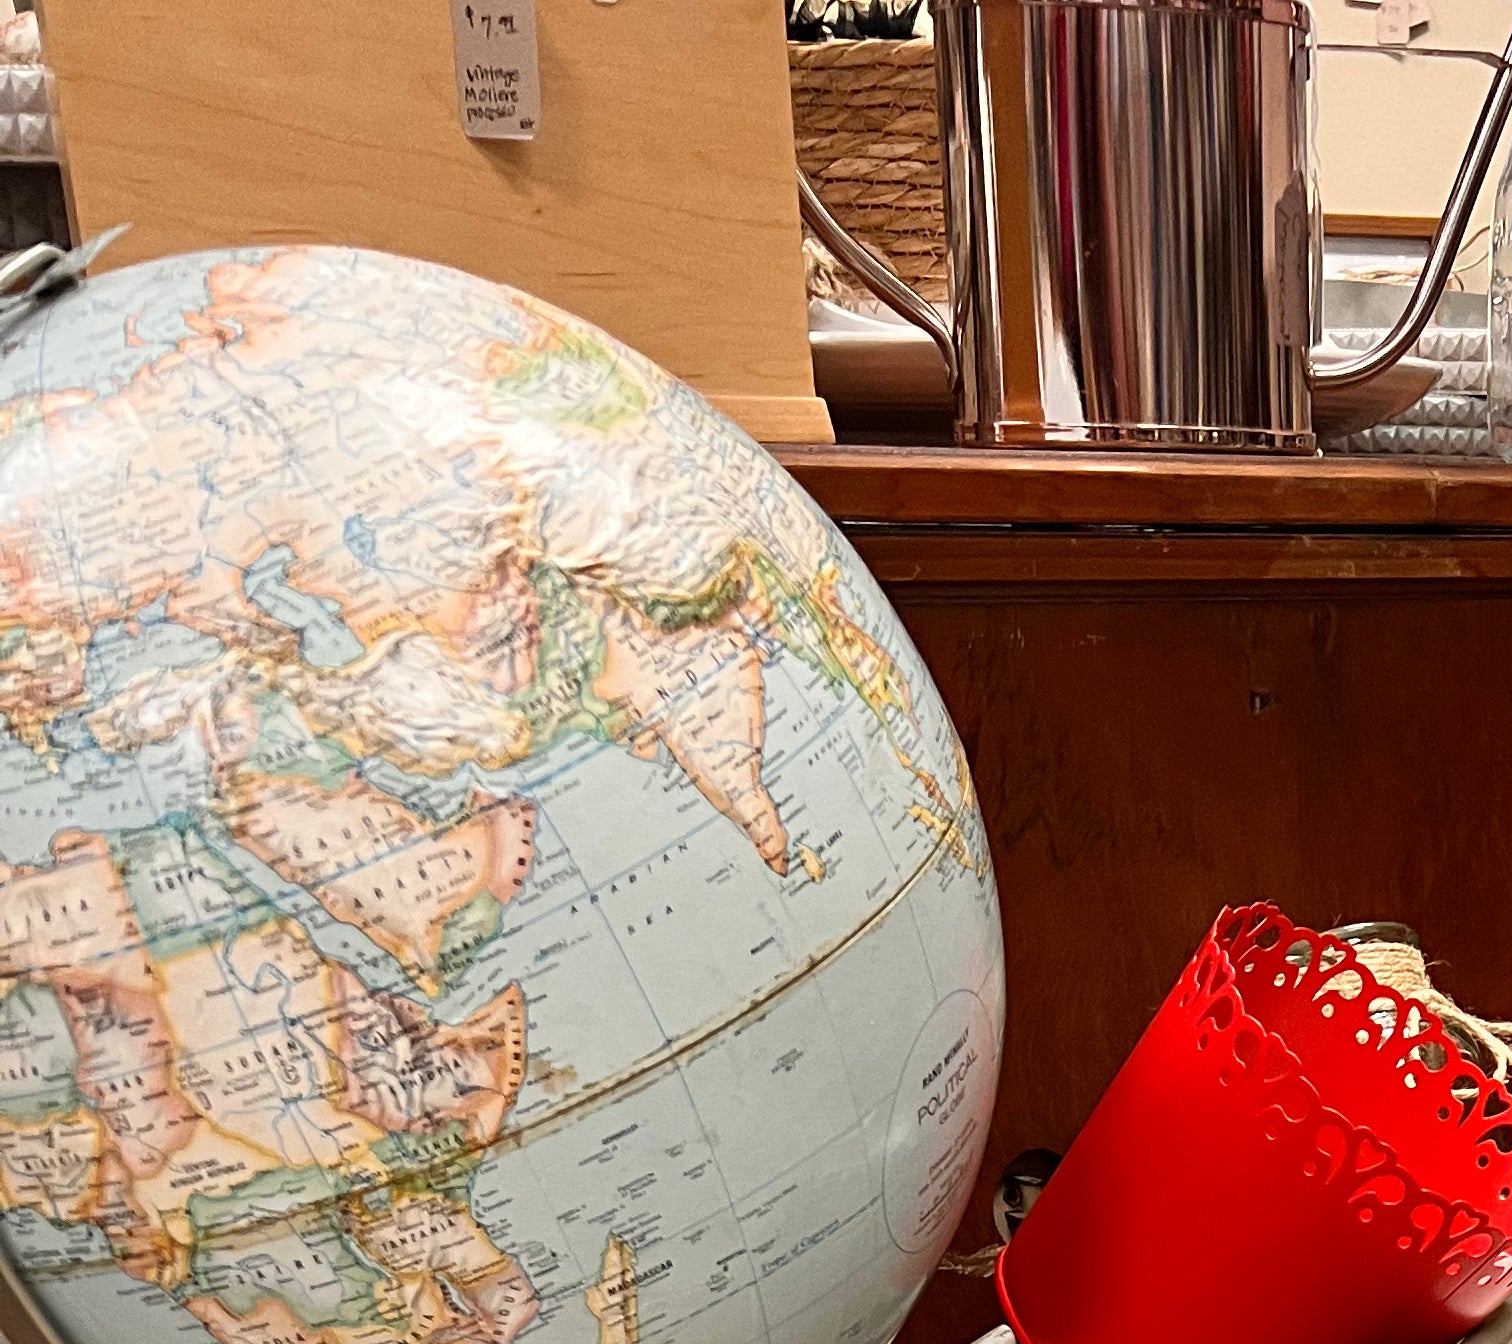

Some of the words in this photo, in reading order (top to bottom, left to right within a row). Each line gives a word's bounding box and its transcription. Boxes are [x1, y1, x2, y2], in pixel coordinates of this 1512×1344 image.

[570, 841, 688, 916] ARABIAN
[627, 905, 674, 936] SEA
[224, 1040, 298, 1073] SUDAN
[917, 1047, 978, 1126] POLITICAL
[922, 1063, 943, 1090] RAND
[381, 1218, 457, 1252] TANZANIA
[236, 1253, 323, 1285] ZAIRE
[607, 1258, 674, 1297] MADAGASCAR
